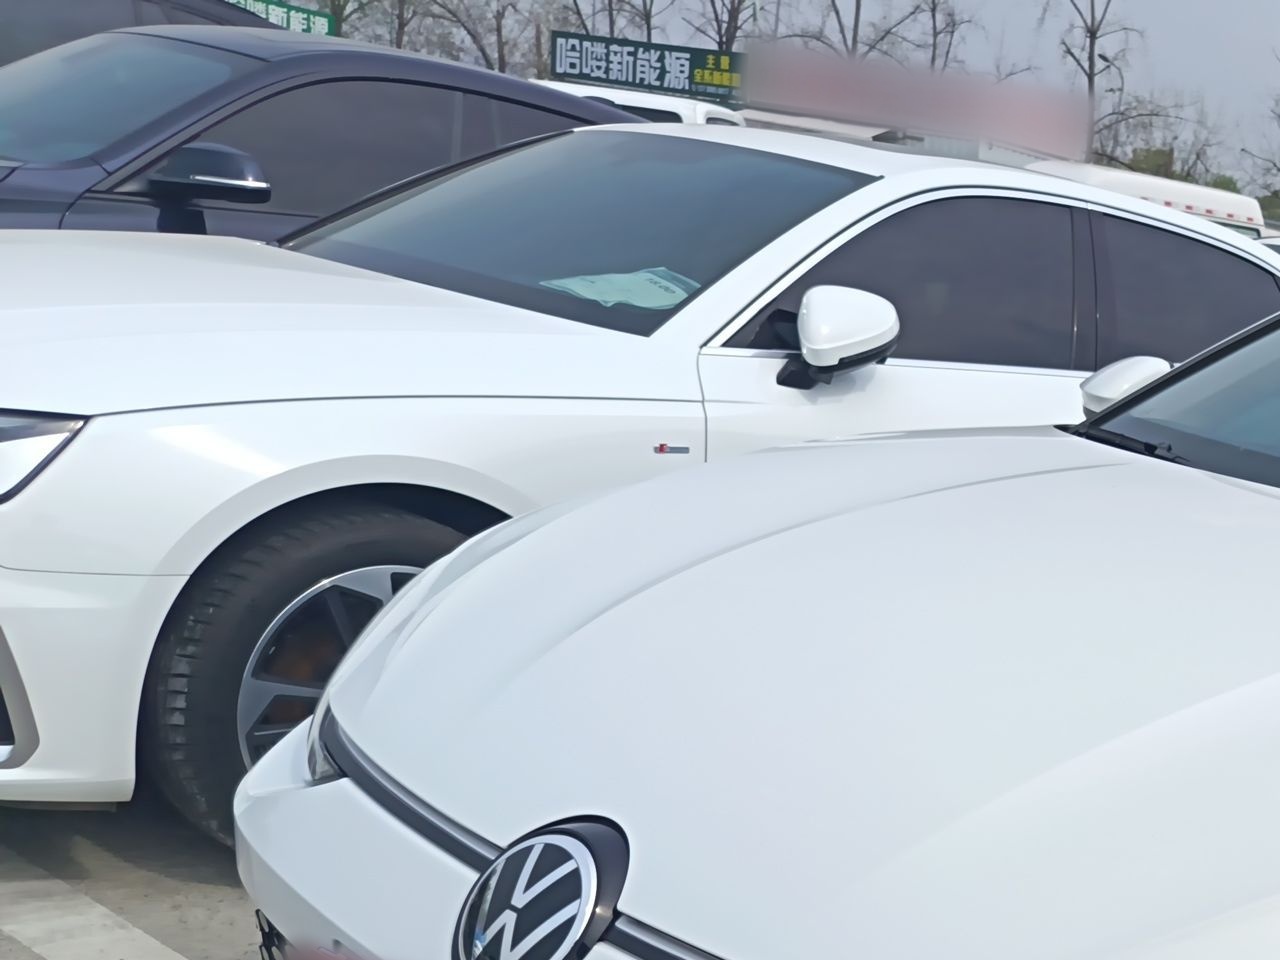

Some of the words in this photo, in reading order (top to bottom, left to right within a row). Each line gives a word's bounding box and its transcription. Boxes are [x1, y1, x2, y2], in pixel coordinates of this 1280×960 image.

[556, 37, 691, 90] 哈喽新能源
